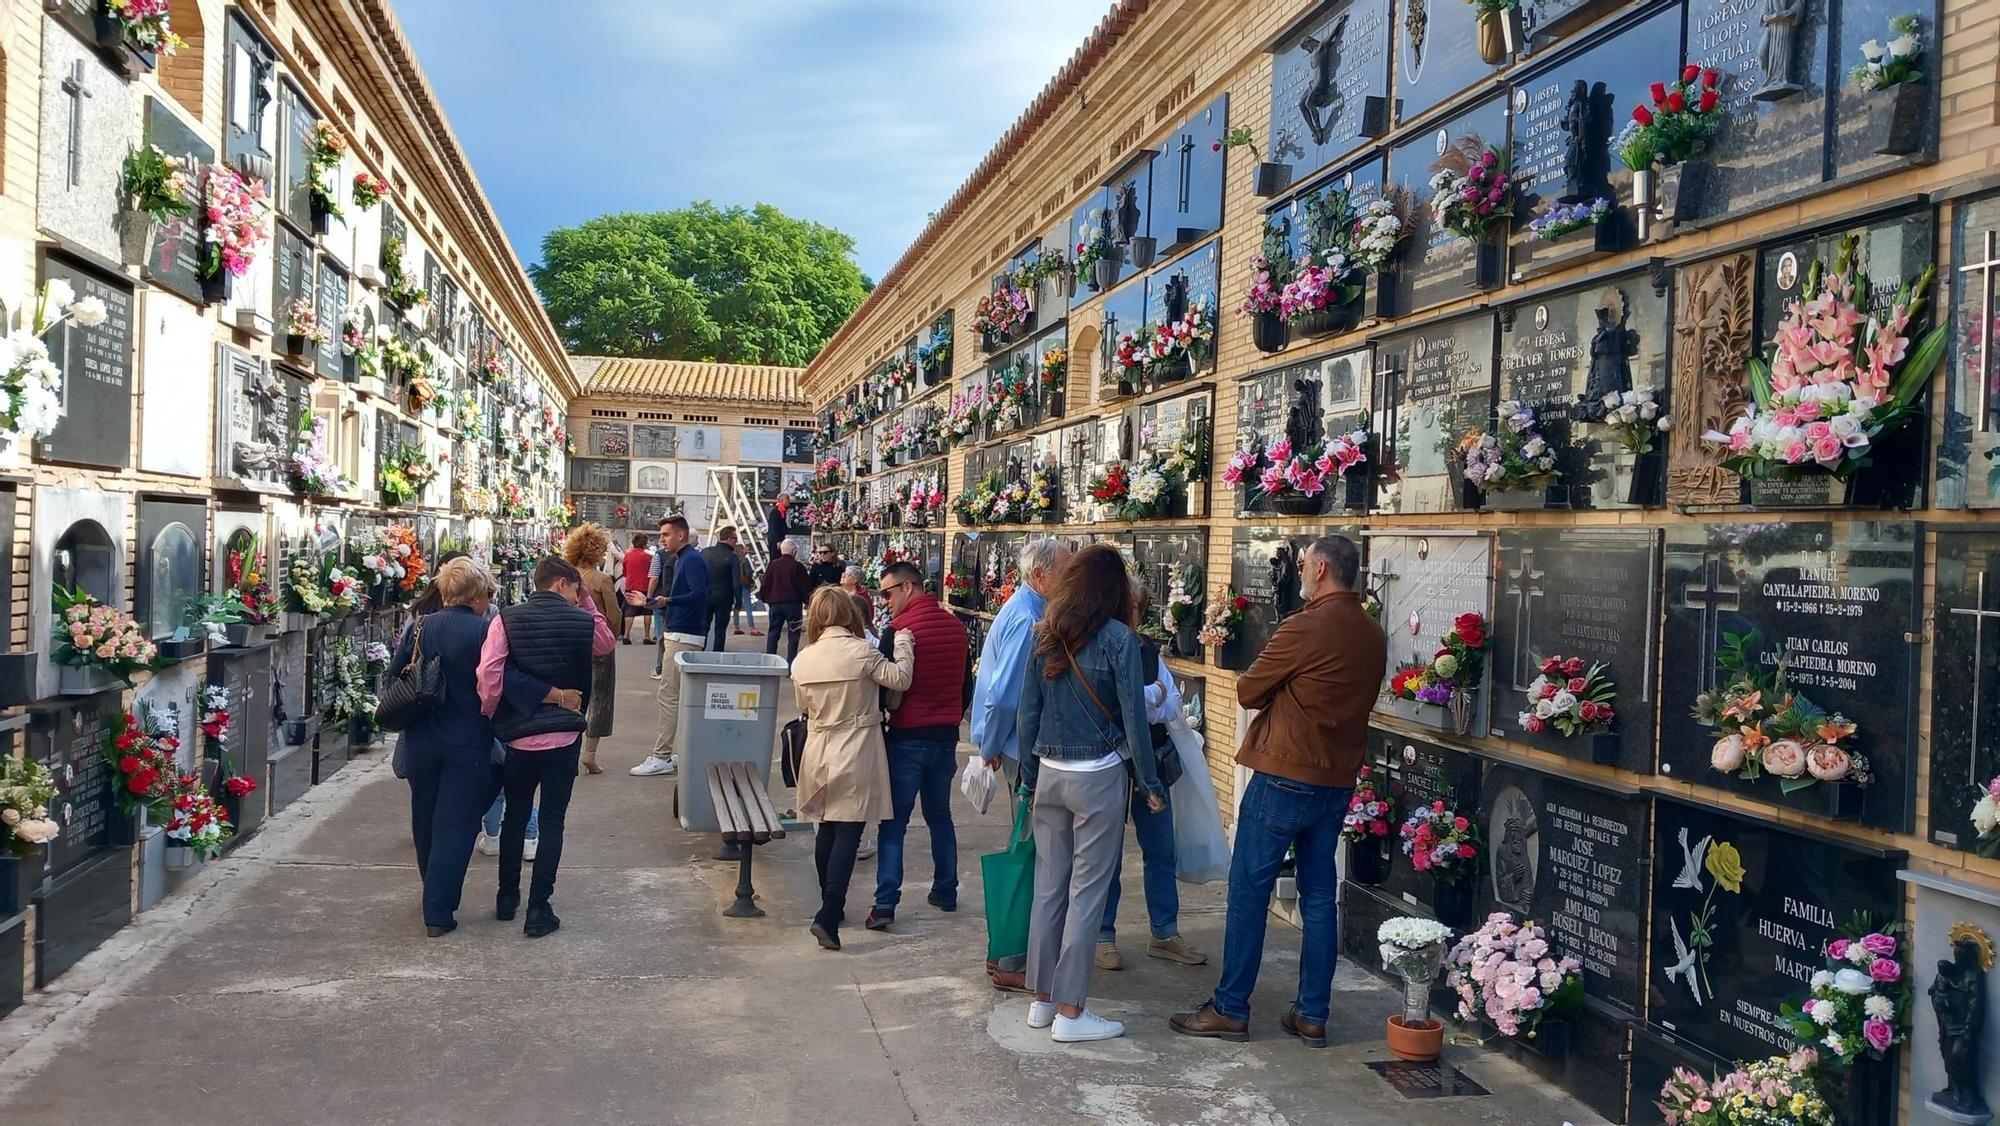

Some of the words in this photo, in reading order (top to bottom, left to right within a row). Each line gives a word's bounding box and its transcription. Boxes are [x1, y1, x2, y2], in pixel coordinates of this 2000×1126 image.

[1697, 0, 1756, 32] LORENZO
[1703, 19, 1748, 50] LLOPIS
[1696, 40, 1754, 73] BARTUAL
[1534, 83, 1560, 104] JOSEFA
[1526, 98, 1562, 123] CHAPARRO
[1526, 115, 1560, 138] CASTILLO
[1426, 336, 1455, 352] AMPARO
[1535, 331, 1566, 347] TERESA
[1505, 353, 1543, 370] BELLVER
[1550, 345, 1584, 362] TORRES
[1551, 366, 1567, 377] 1979
[1799, 567, 1840, 581] MANUEL
[1763, 583, 1837, 599] CANTALAPIEDRA
[1840, 586, 1880, 602] MORENO
[1825, 604, 1863, 617] 25-2-1979
[1785, 636, 1809, 651] JUAN
[1812, 639, 1849, 656] CARLOS
[1760, 651, 1834, 672] CANLAPIEDRA
[1837, 658, 1877, 677] MORENO
[1821, 675, 1857, 690] 2-5-2004
[1558, 806, 1582, 821] AGUARDAN
[1583, 813, 1590, 824] LA
[1552, 816, 1563, 829] LOS
[1563, 820, 1582, 835] RESTOS
[1584, 827, 1610, 844] MORTALES
[1612, 835, 1620, 847] DE
[1571, 837, 1594, 857] JOSE
[1549, 846, 1589, 873] MARQUEZ
[1593, 861, 1622, 885] LOPEZ
[1559, 880, 1568, 891] AVE
[1569, 883, 1585, 898] MARIA
[1564, 898, 1600, 924] AMPARO
[1783, 896, 1835, 929] FAMILIA
[1552, 911, 1584, 938] ROSELL
[1588, 926, 1618, 952] ARCON
[1758, 918, 1806, 951] HUERVA
[1584, 958, 1611, 978] CONCEBIDA
[1736, 999, 1772, 1025] SIEMPRE
[1720, 1009, 1731, 1024] EN
[1732, 1016, 1775, 1045] NUESTROS
